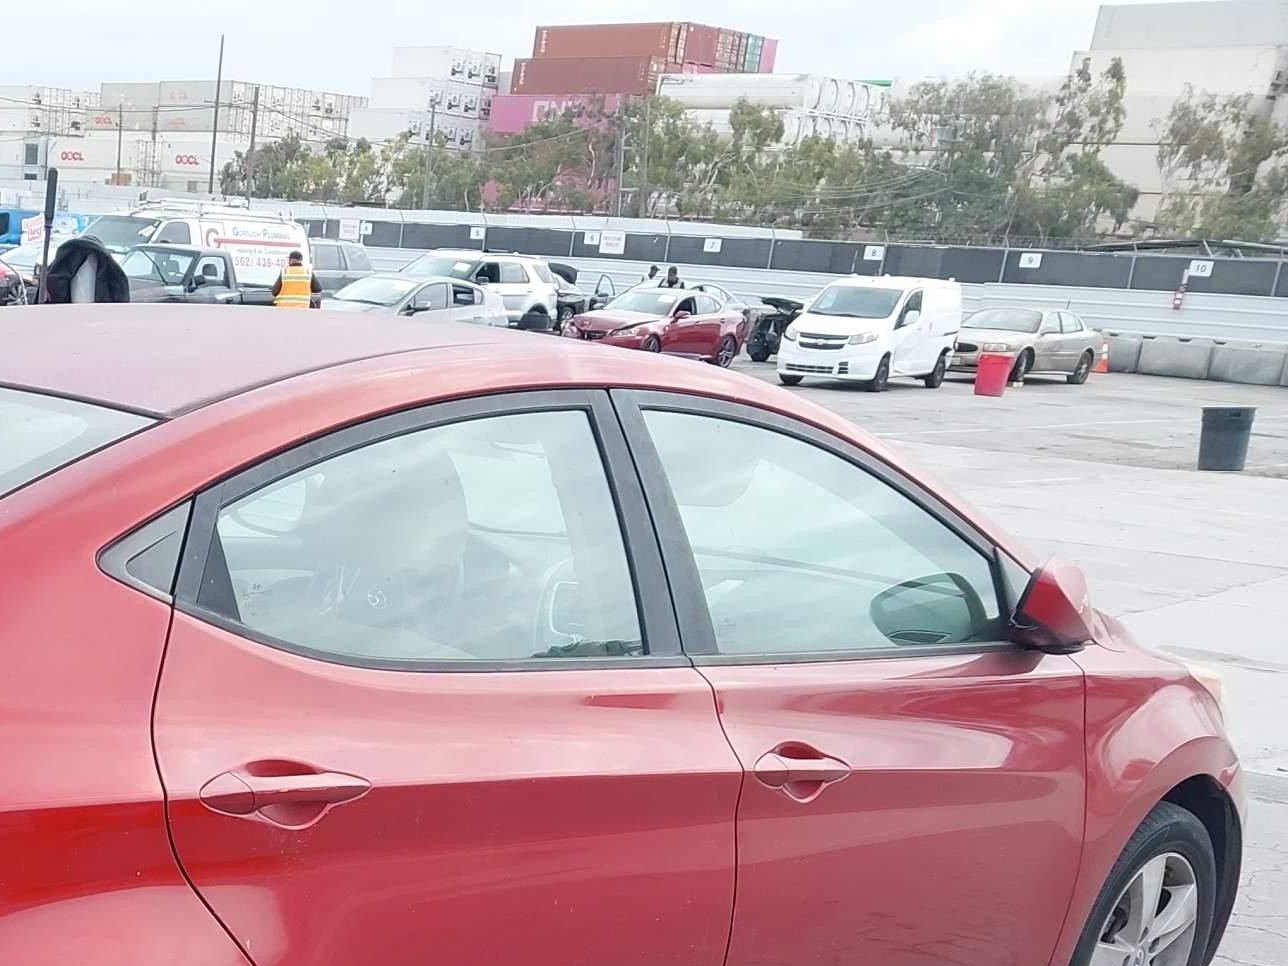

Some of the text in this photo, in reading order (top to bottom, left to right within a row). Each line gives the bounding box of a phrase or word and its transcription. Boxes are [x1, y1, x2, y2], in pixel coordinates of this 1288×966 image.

[61, 151, 84, 162] OOCL
[176, 154, 199, 166] OOCL
[1195, 264, 1207, 273] 10
